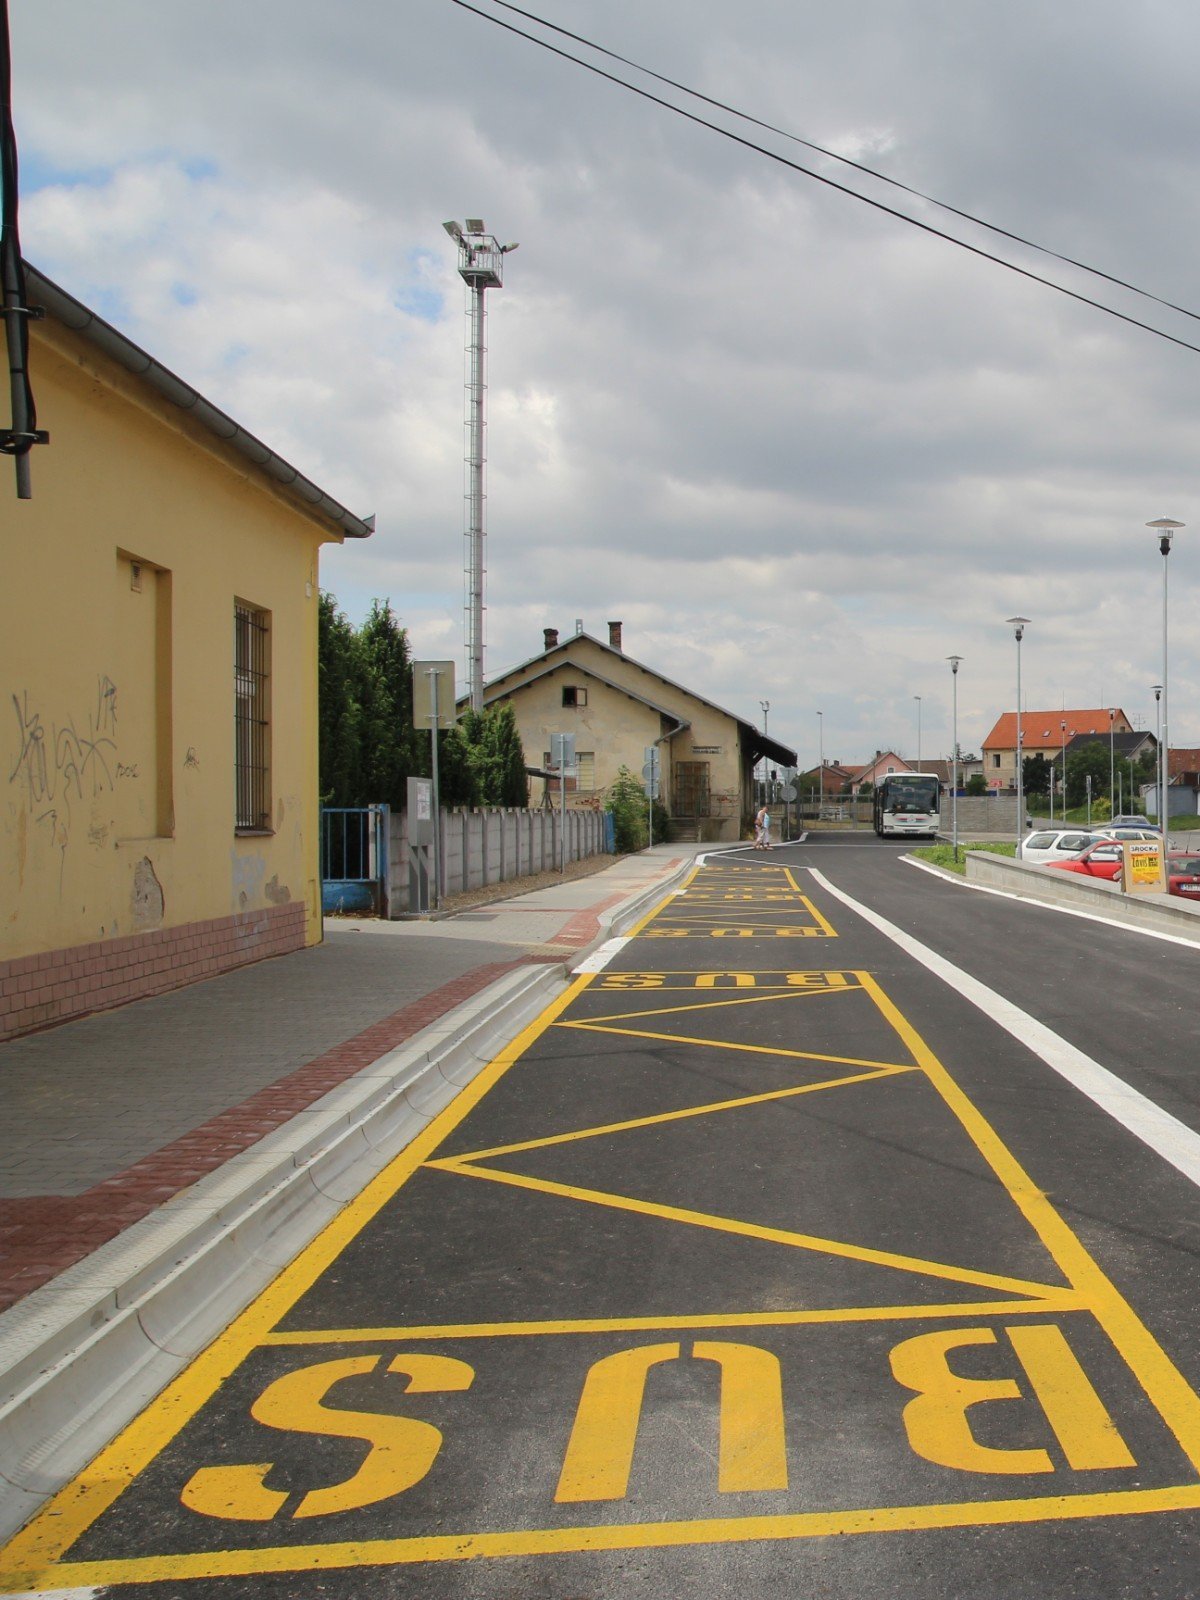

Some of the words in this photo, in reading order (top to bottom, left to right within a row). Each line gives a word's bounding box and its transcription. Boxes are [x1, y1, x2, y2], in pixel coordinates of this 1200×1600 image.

[645, 928, 818, 937] BUS
[601, 972, 848, 988] BUS
[181, 1324, 1138, 1520] BUS
